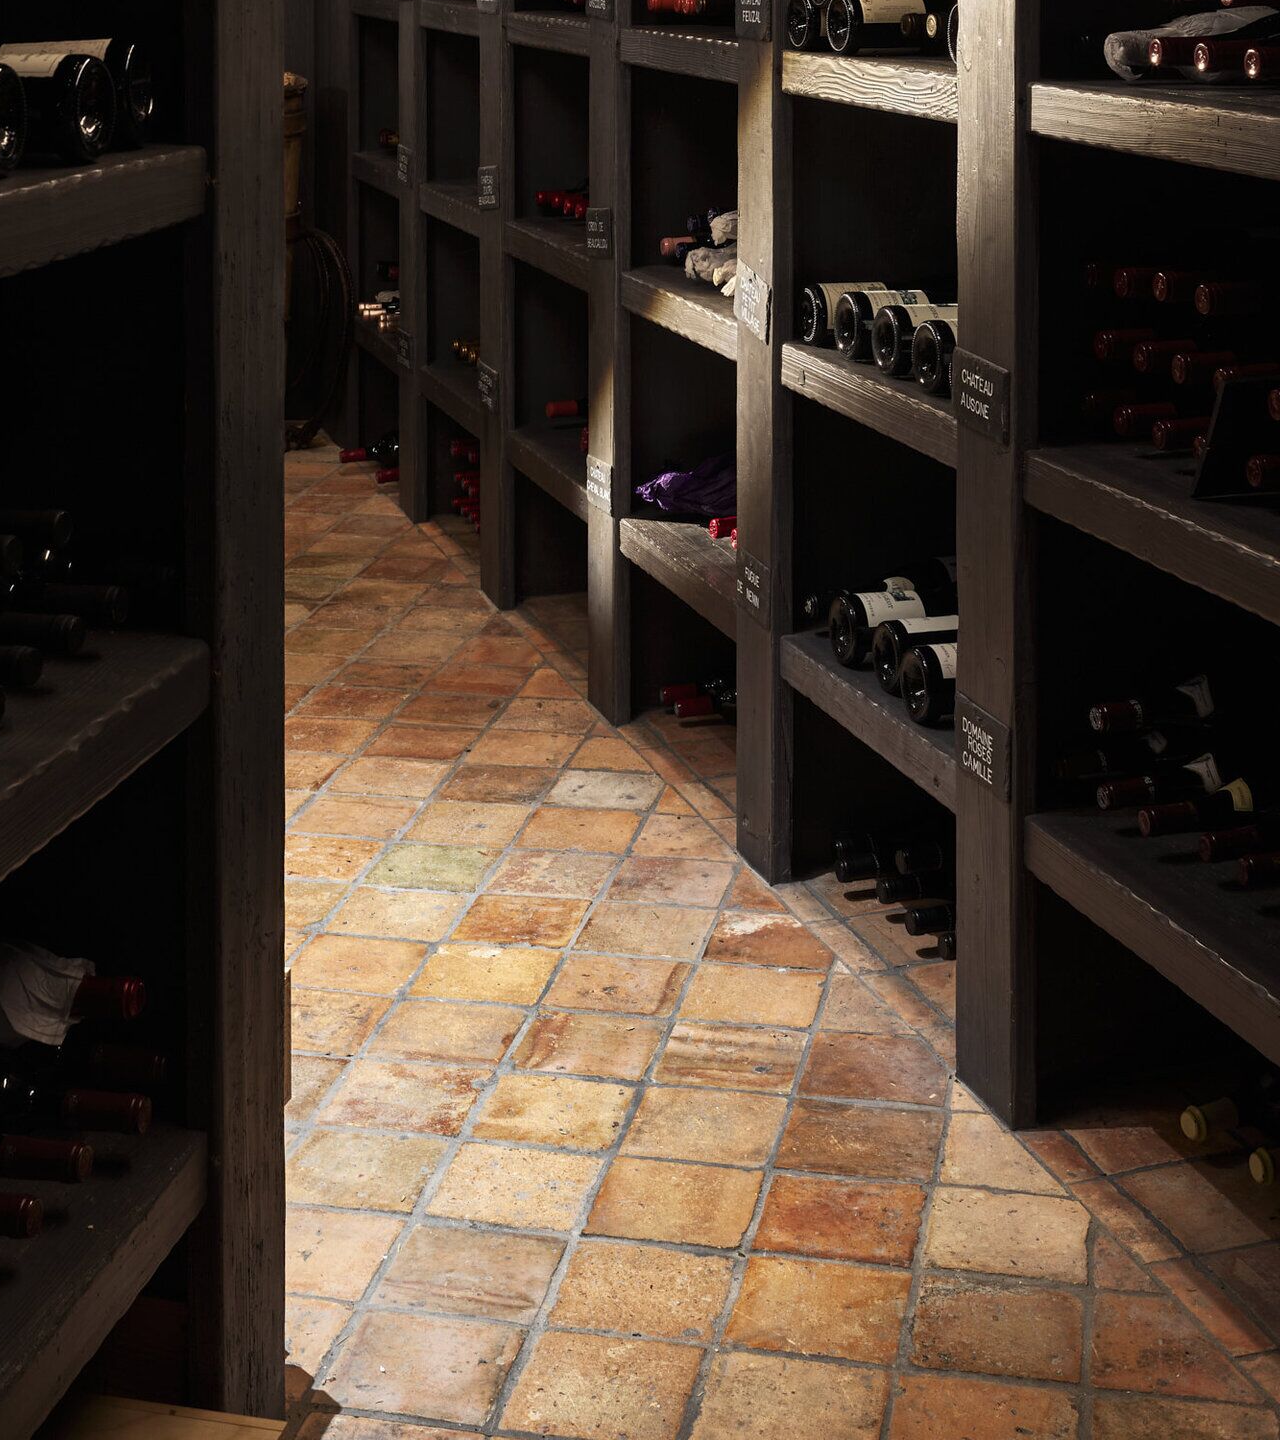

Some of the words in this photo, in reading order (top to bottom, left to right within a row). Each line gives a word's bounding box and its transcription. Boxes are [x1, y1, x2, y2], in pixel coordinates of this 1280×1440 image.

[961, 368, 994, 397] CHATEAU
[960, 392, 990, 420] AUSONE
[737, 579, 744, 594] DE
[962, 716, 994, 751] DOMAINE
[967, 736, 992, 765] ROSES
[962, 750, 993, 785] CAMILLE
